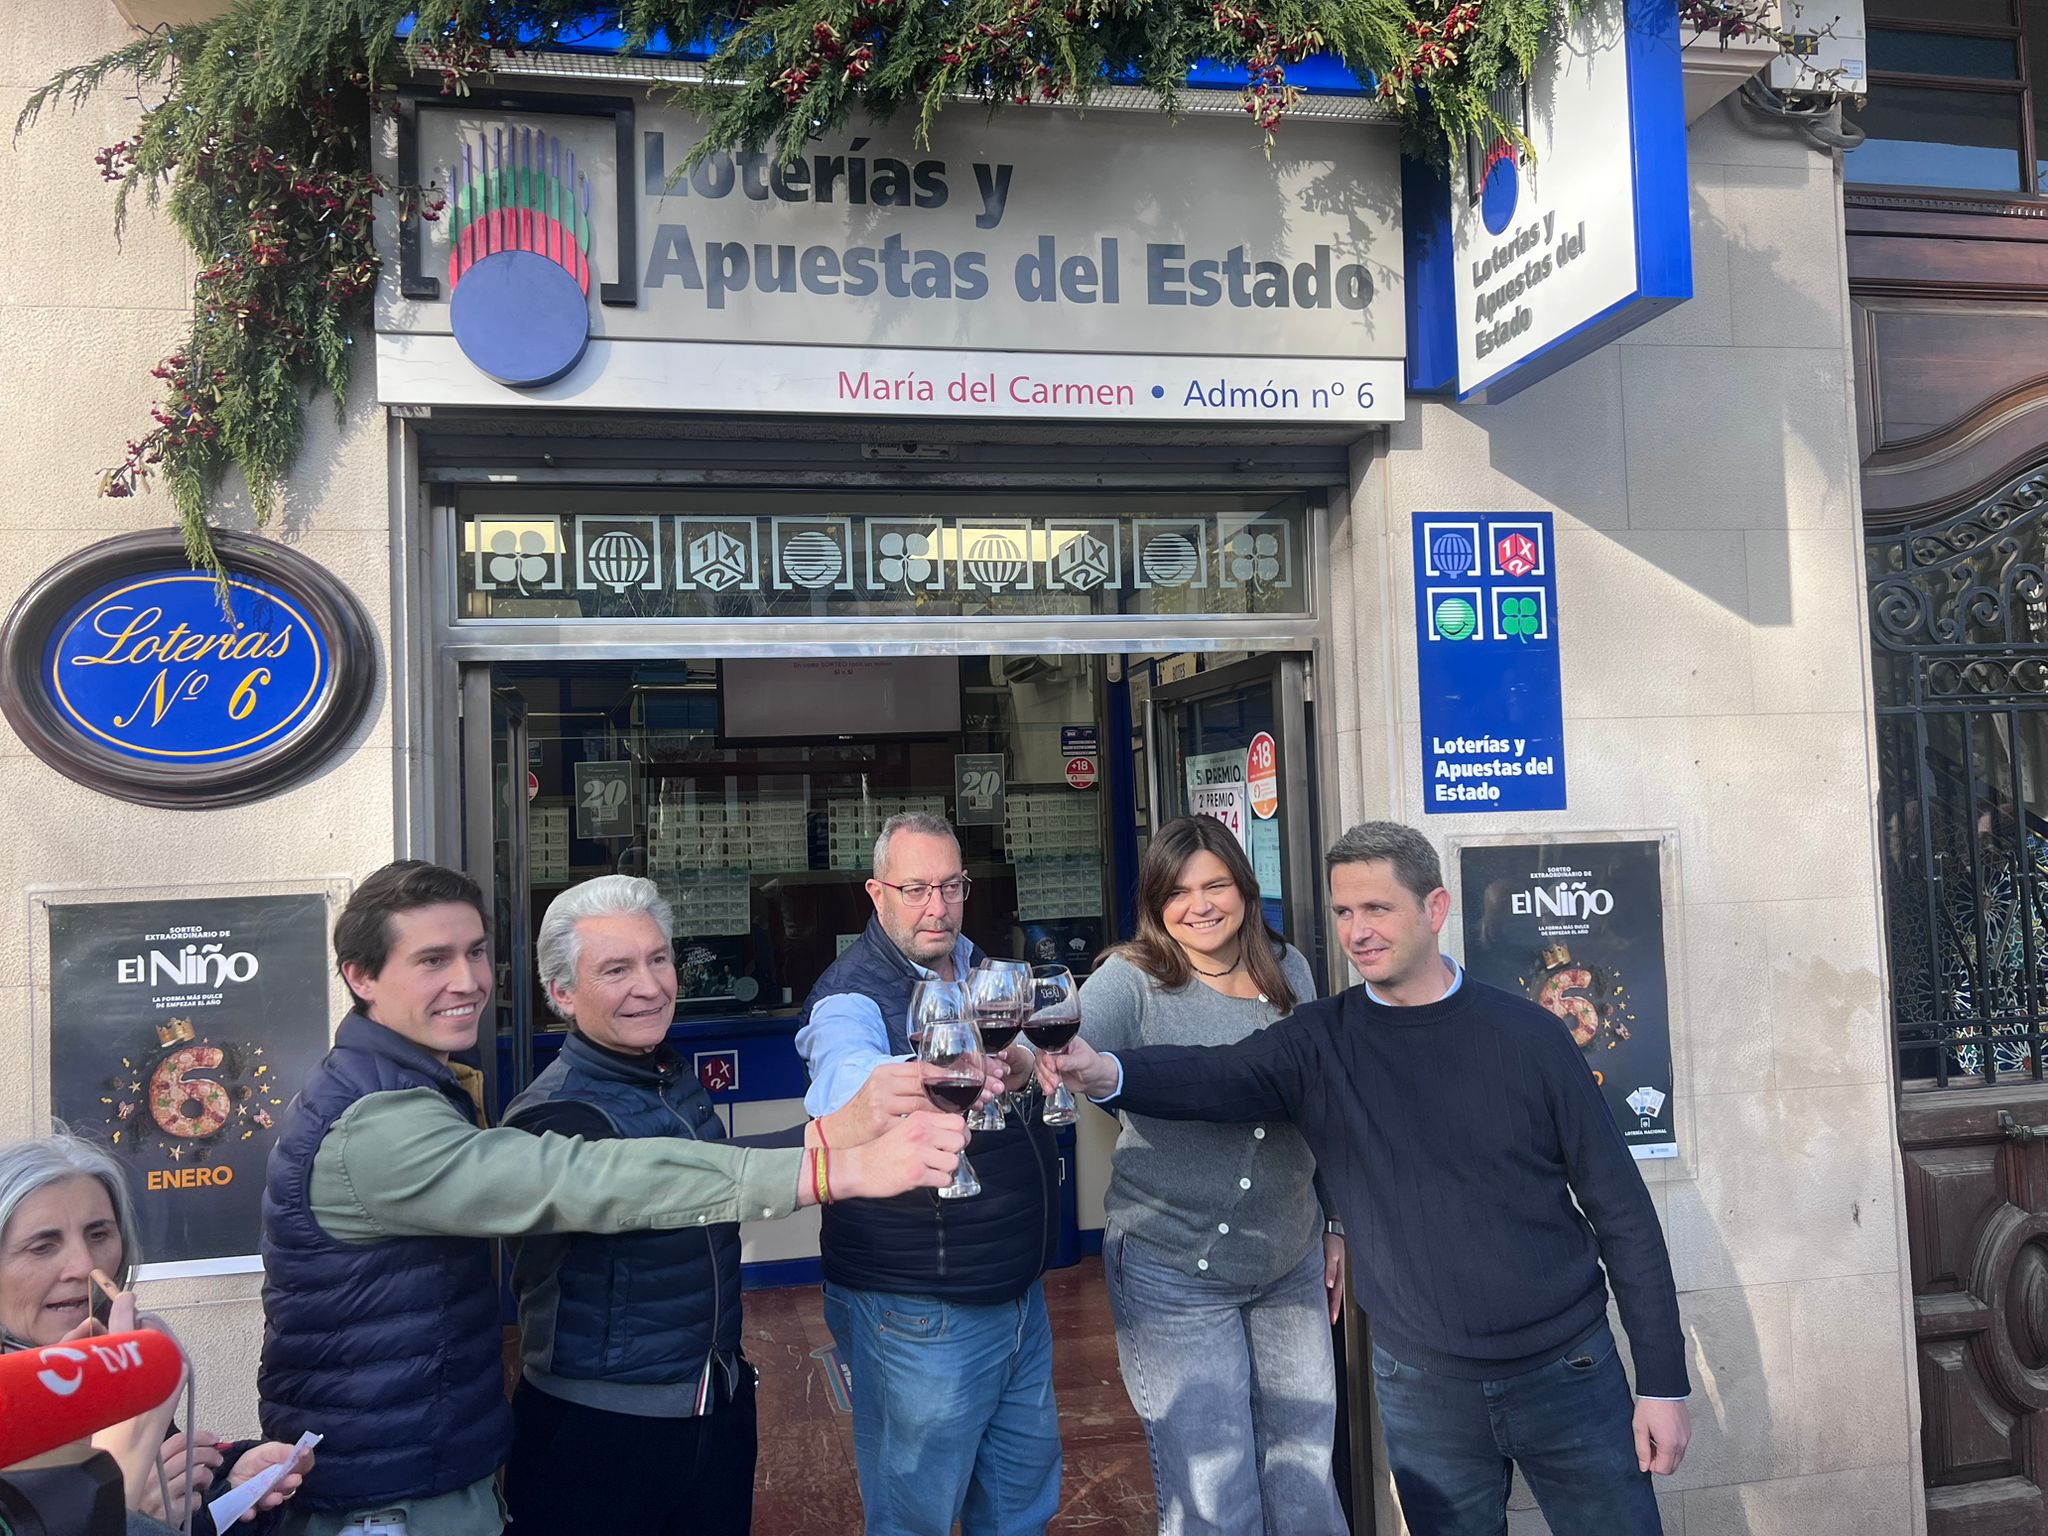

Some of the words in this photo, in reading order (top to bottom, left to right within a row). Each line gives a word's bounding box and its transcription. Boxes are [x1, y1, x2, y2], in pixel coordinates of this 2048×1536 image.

[644, 131, 950, 209] Loterías
[973, 163, 1013, 229] y
[1472, 221, 1541, 288] Loterías
[1542, 210, 1556, 246] y
[643, 223, 989, 309] Apuestas
[1014, 235, 1120, 304] del
[1146, 243, 1374, 310] Estado
[1475, 253, 1553, 324] Apuestas
[1556, 220, 1586, 268] del
[1475, 304, 1534, 360] Estado
[838, 371, 934, 402] María
[947, 373, 996, 403] del
[1009, 376, 1135, 406] Carmen
[1184, 379, 1299, 409] Admón
[1312, 382, 1345, 409] nº
[1357, 383, 1375, 409] 6
[113, 668, 209, 728] Nº
[228, 667, 271, 720] 6
[1252, 741, 1272, 769] +18
[1433, 735, 1510, 754] Loterías
[1514, 739, 1526, 757] y
[1072, 760, 1088, 771] +18
[1205, 765, 1241, 784] PREMIO
[1435, 759, 1522, 782] Apuestas
[1525, 756, 1554, 775] del
[1207, 792, 1234, 808] PREMIO
[1435, 782, 1501, 801] Estado
[1534, 881, 1614, 920] Niño
[145, 931, 218, 940] EXTRAORDINARIO
[151, 943, 259, 988] Niño
[166, 1000, 197, 1008] EMPEZAR
[150, 1046, 232, 1138] 6
[147, 1165, 233, 1191] ENERO
[90, 1340, 143, 1374] tvr
